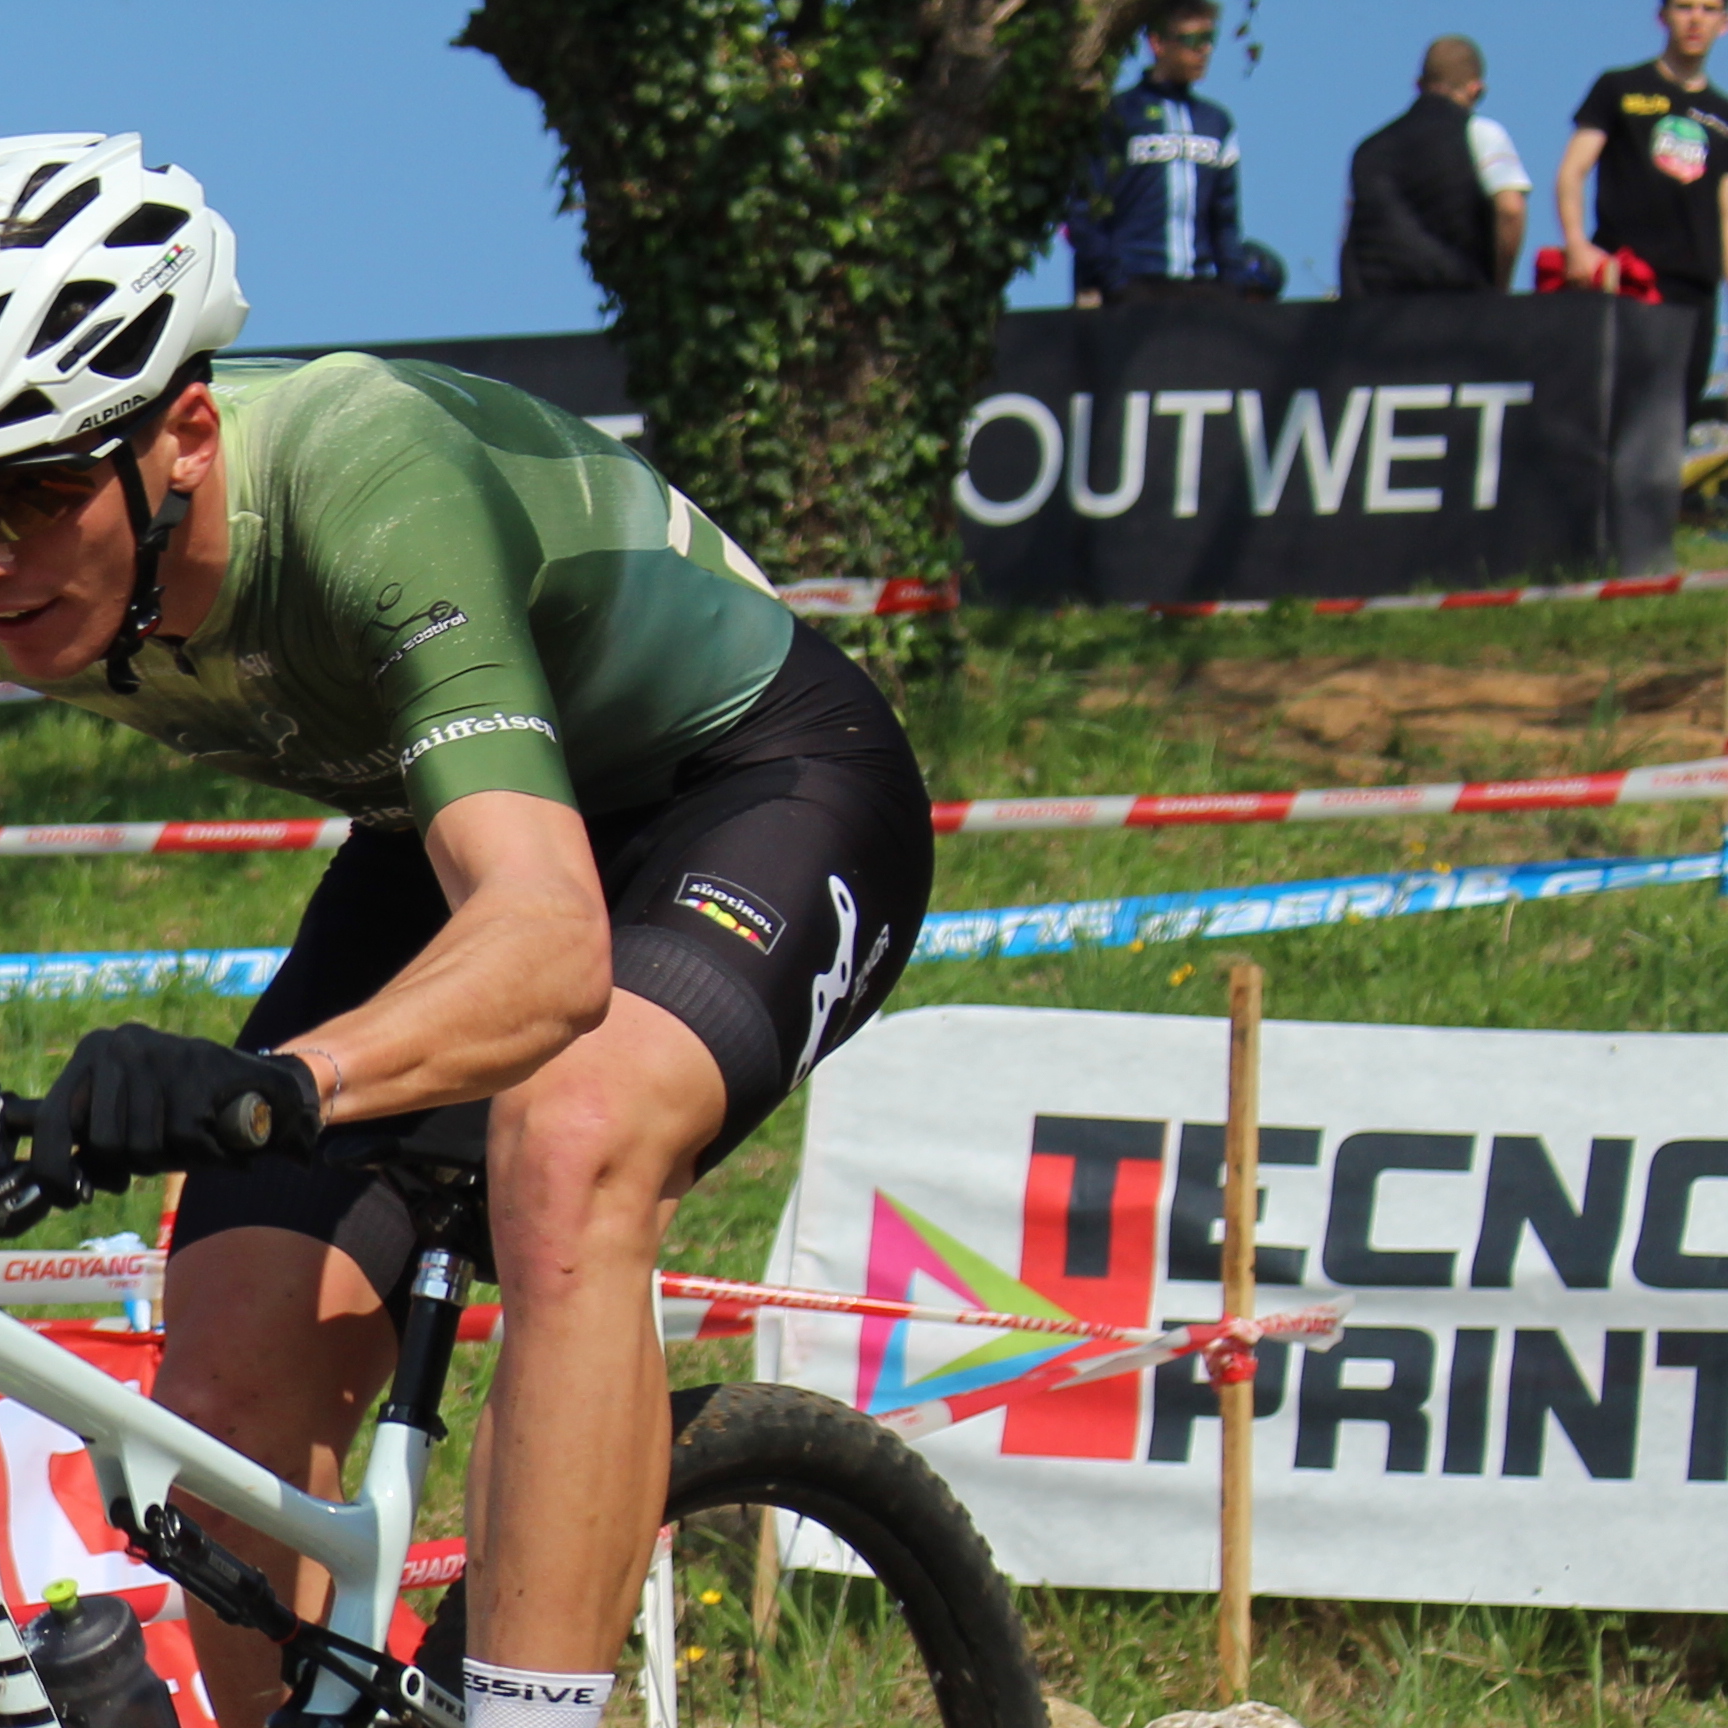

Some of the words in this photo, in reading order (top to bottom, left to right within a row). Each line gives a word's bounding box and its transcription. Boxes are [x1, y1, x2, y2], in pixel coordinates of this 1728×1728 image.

[77, 393, 148, 434] ALPINA
[952, 381, 1535, 528] OUTWET
[398, 712, 558, 777] Raiffeisen
[3, 1255, 144, 1283] CHAOYANG
